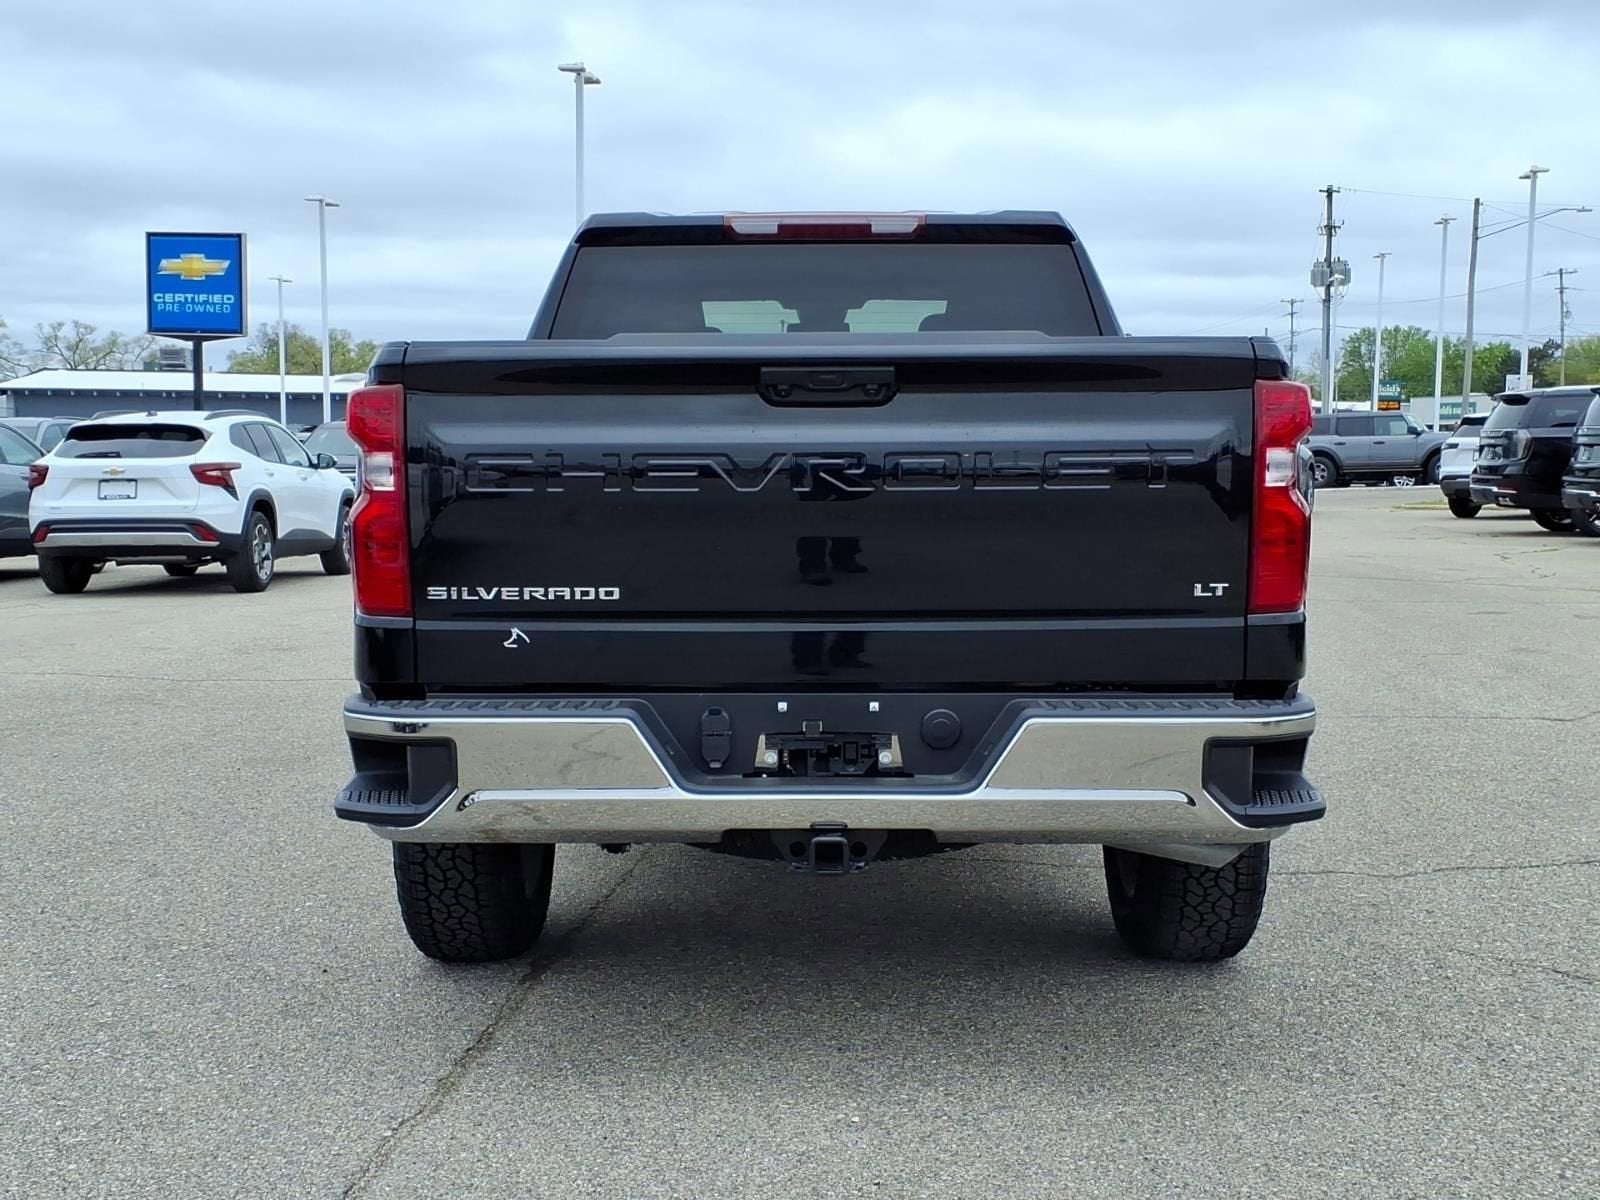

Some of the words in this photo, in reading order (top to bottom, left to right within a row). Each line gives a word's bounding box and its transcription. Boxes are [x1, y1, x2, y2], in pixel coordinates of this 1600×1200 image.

[153, 293, 235, 303] CERTIFIED
[157, 303, 231, 313] PRE-OWNED
[464, 451, 1194, 492] CHEVROLET
[426, 586, 620, 600] SILVERADO
[1194, 583, 1229, 596] LT
